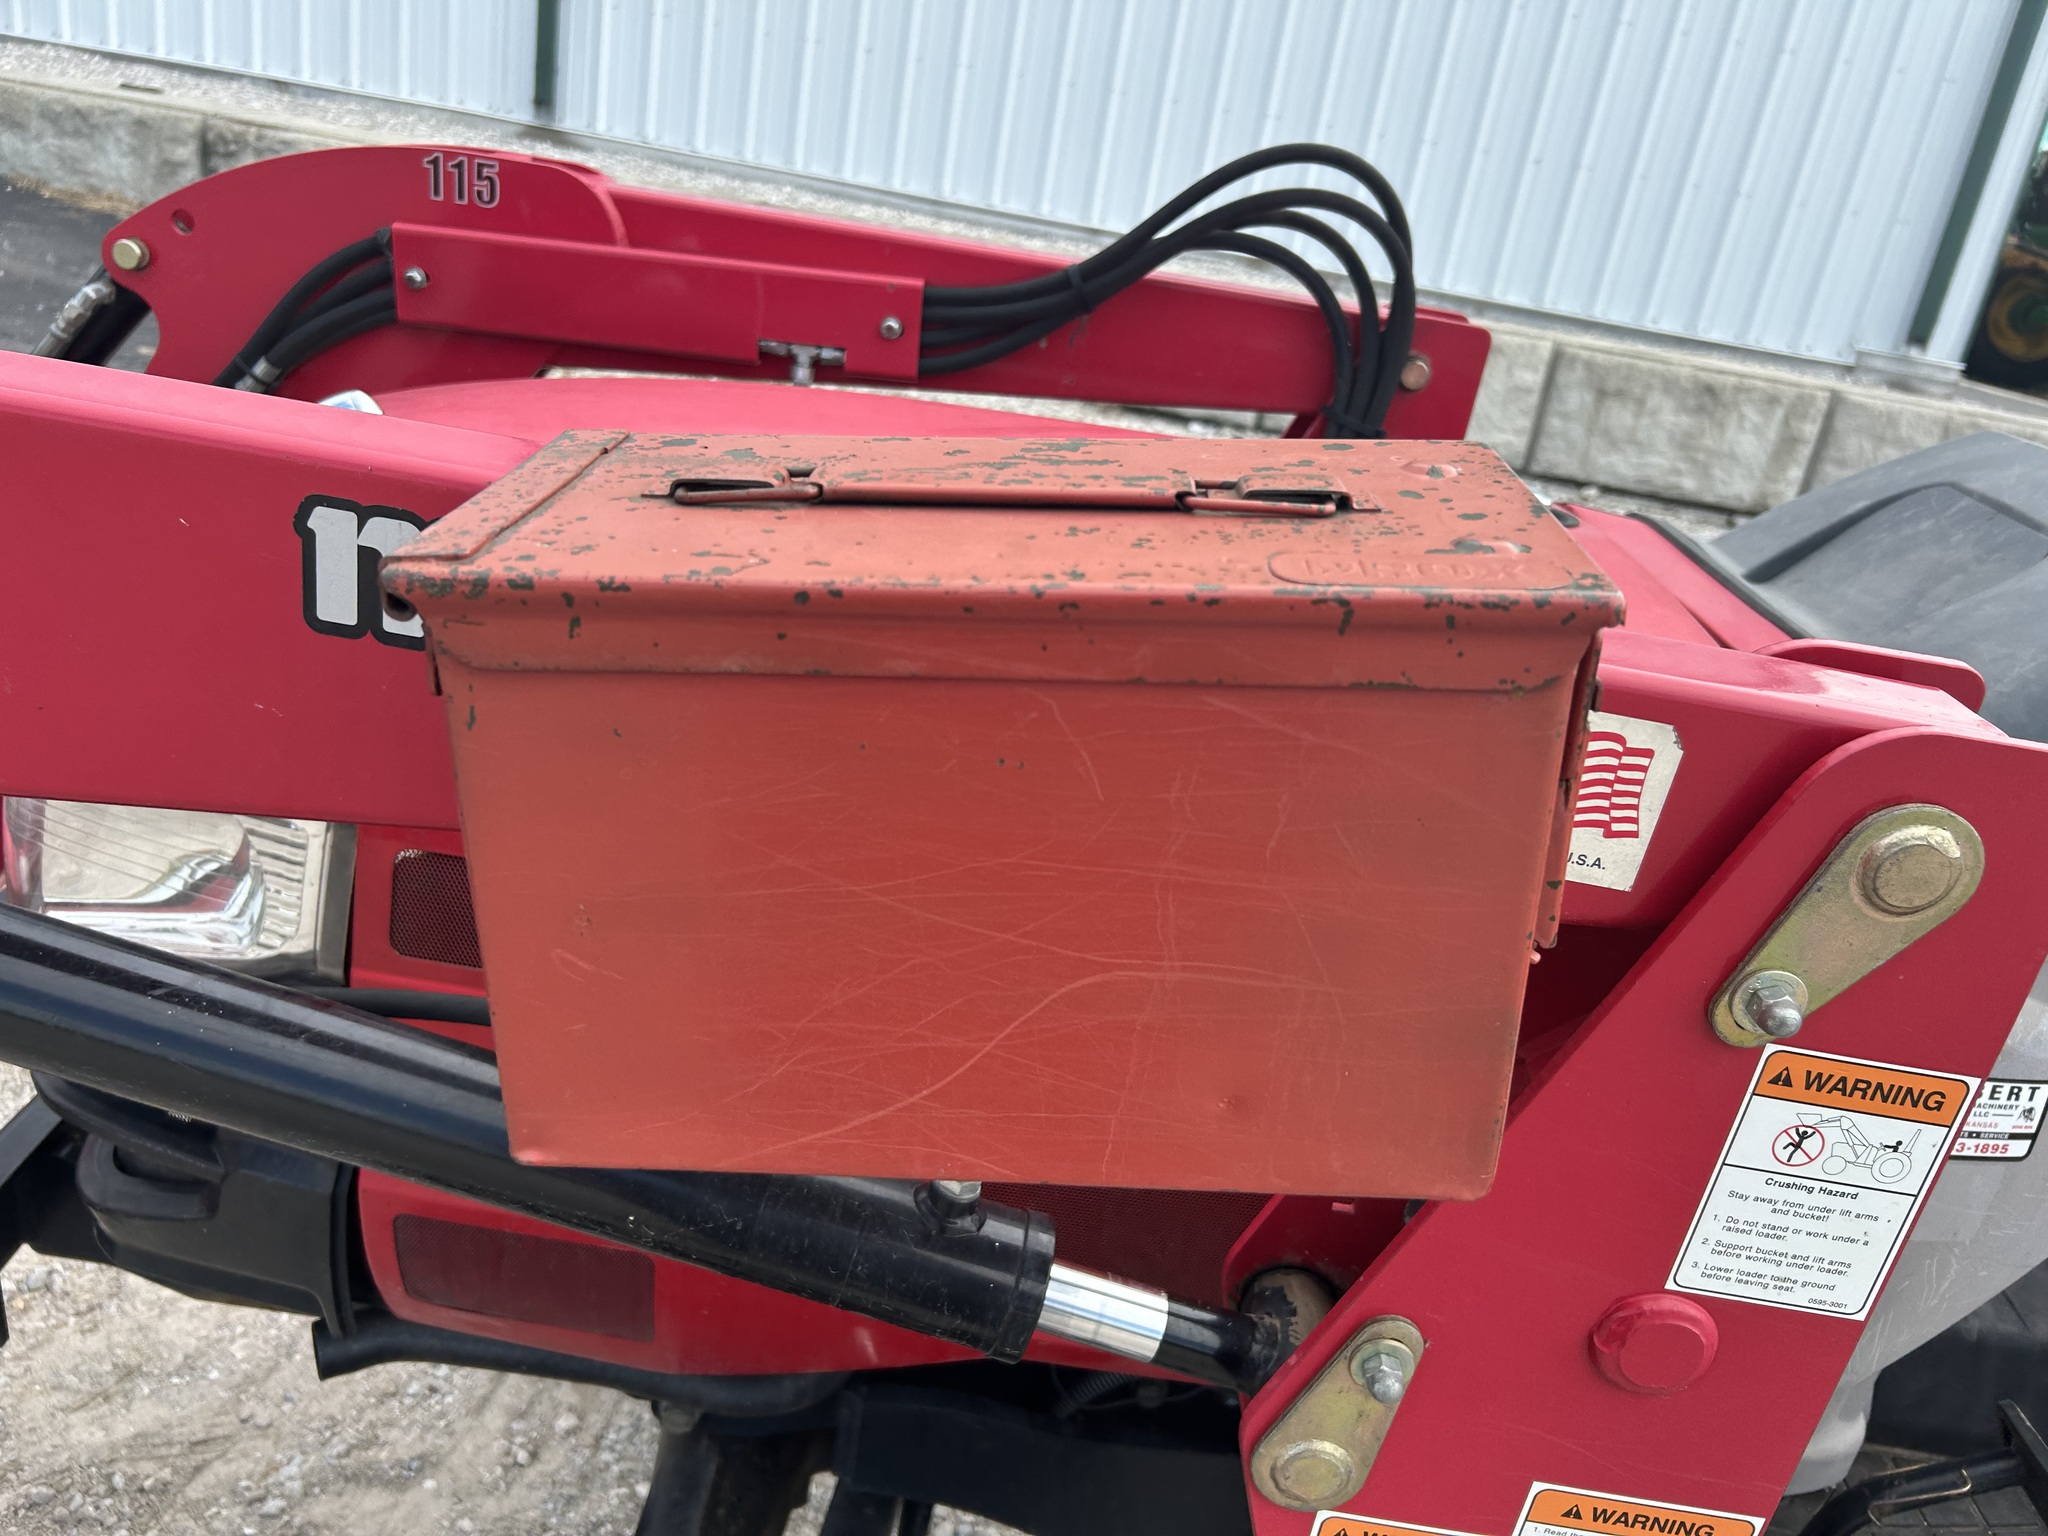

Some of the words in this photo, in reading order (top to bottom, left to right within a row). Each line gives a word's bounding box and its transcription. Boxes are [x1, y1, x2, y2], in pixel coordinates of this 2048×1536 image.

[422, 152, 500, 208] 115
[1803, 1069, 1947, 1112] WARNING
[1979, 1084, 2041, 1102] ERT
[1973, 1102, 2020, 1111] ACHINERY
[1764, 1177, 1816, 1194] Crushing
[1818, 1186, 1859, 1200] Hazard
[1728, 1190, 1750, 1201] Stay
[1752, 1195, 1779, 1206] away
[1782, 1199, 1804, 1210] from
[1808, 1203, 1837, 1215] under
[1839, 1208, 1852, 1217] lift
[1854, 1212, 1879, 1222] arms
[1770, 1206, 1790, 1216] and
[1793, 1209, 1830, 1222] bucket!
[1713, 1214, 1720, 1222] 1.
[1726, 1216, 1740, 1224] Do
[1742, 1219, 1758, 1228] not
[1761, 1222, 1789, 1233] stand
[1805, 1228, 1829, 1240] work
[1832, 1233, 1860, 1245] under
[1722, 1224, 1752, 1235] raised
[1755, 1230, 1788, 1242] loader.
[1701, 1238, 1710, 1246] 2.
[1714, 1239, 1753, 1253] Support
[1755, 1246, 1788, 1258] bucket
[1790, 1252, 1809, 1262] and
[1812, 1256, 1825, 1265] lift
[1828, 1260, 1852, 1269] arms
[1710, 1248, 1742, 1259] before
[1745, 1254, 1783, 1267] working
[1785, 1260, 1815, 1271] under
[1816, 1265, 1849, 1277] loader.
[1691, 1261, 1700, 1269] 3.
[1704, 1263, 1734, 1274] Lower
[1736, 1268, 1768, 1280] loader
[1770, 1274, 1780, 1282] to
[1782, 1276, 1799, 1285] the
[1801, 1280, 1836, 1292] ground
[1700, 1271, 1732, 1282] before
[1734, 1277, 1770, 1290] leaving
[1772, 1284, 1796, 1293] seat.
[1807, 1298, 1848, 1309] 0595-3001
[1544, 1528, 1567, 1536] Read
[1592, 1506, 1715, 1536] WARNING
